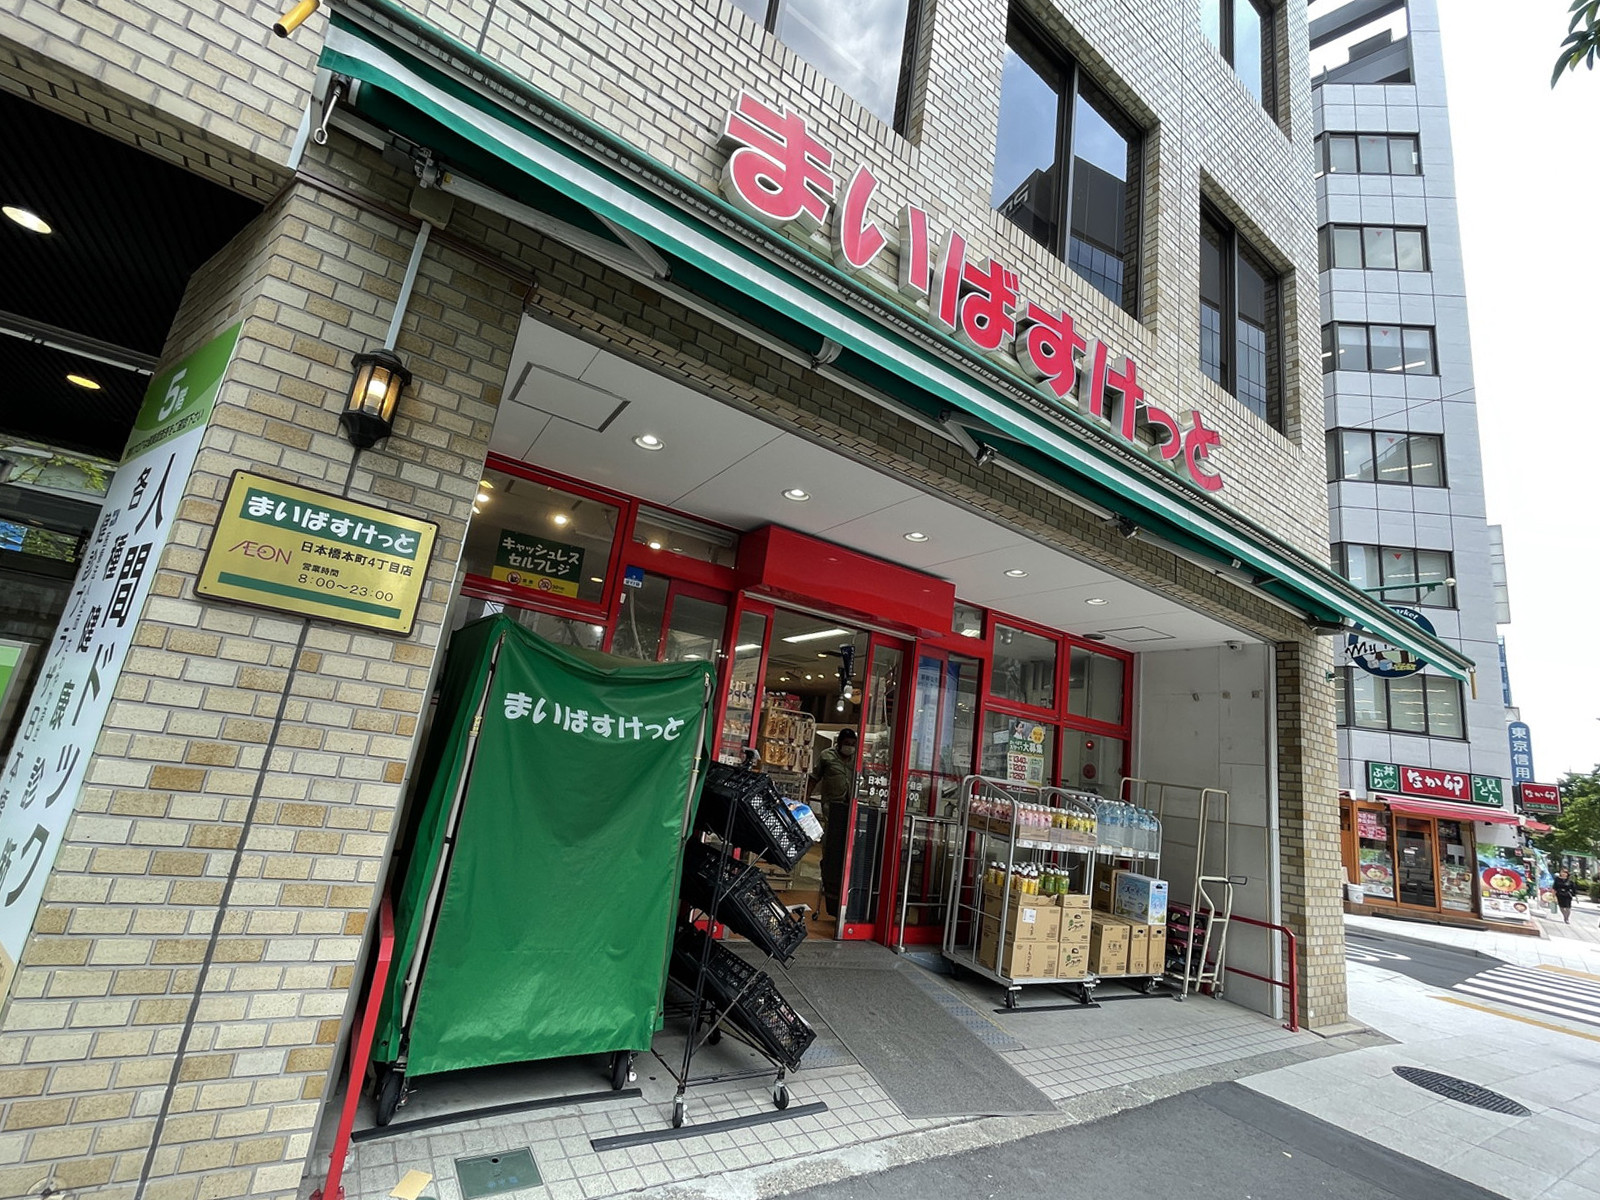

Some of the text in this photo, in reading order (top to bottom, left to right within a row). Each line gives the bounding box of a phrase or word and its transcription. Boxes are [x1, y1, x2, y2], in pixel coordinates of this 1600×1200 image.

[718, 89, 1224, 492] まいばすけっと
[247, 495, 416, 555] まいばすけっと
[300, 540, 415, 578] 日本橋本町4丁目店
[302, 561, 341, 578] 営業時間
[502, 536, 580, 566] キャッシュレス
[508, 552, 570, 576] セルフレジ
[5, 452, 176, 908] 人間ドック
[503, 691, 685, 742] まいばすけっと
[1510, 727, 1531, 786] 東京信用
[1406, 768, 1464, 797] なか卯
